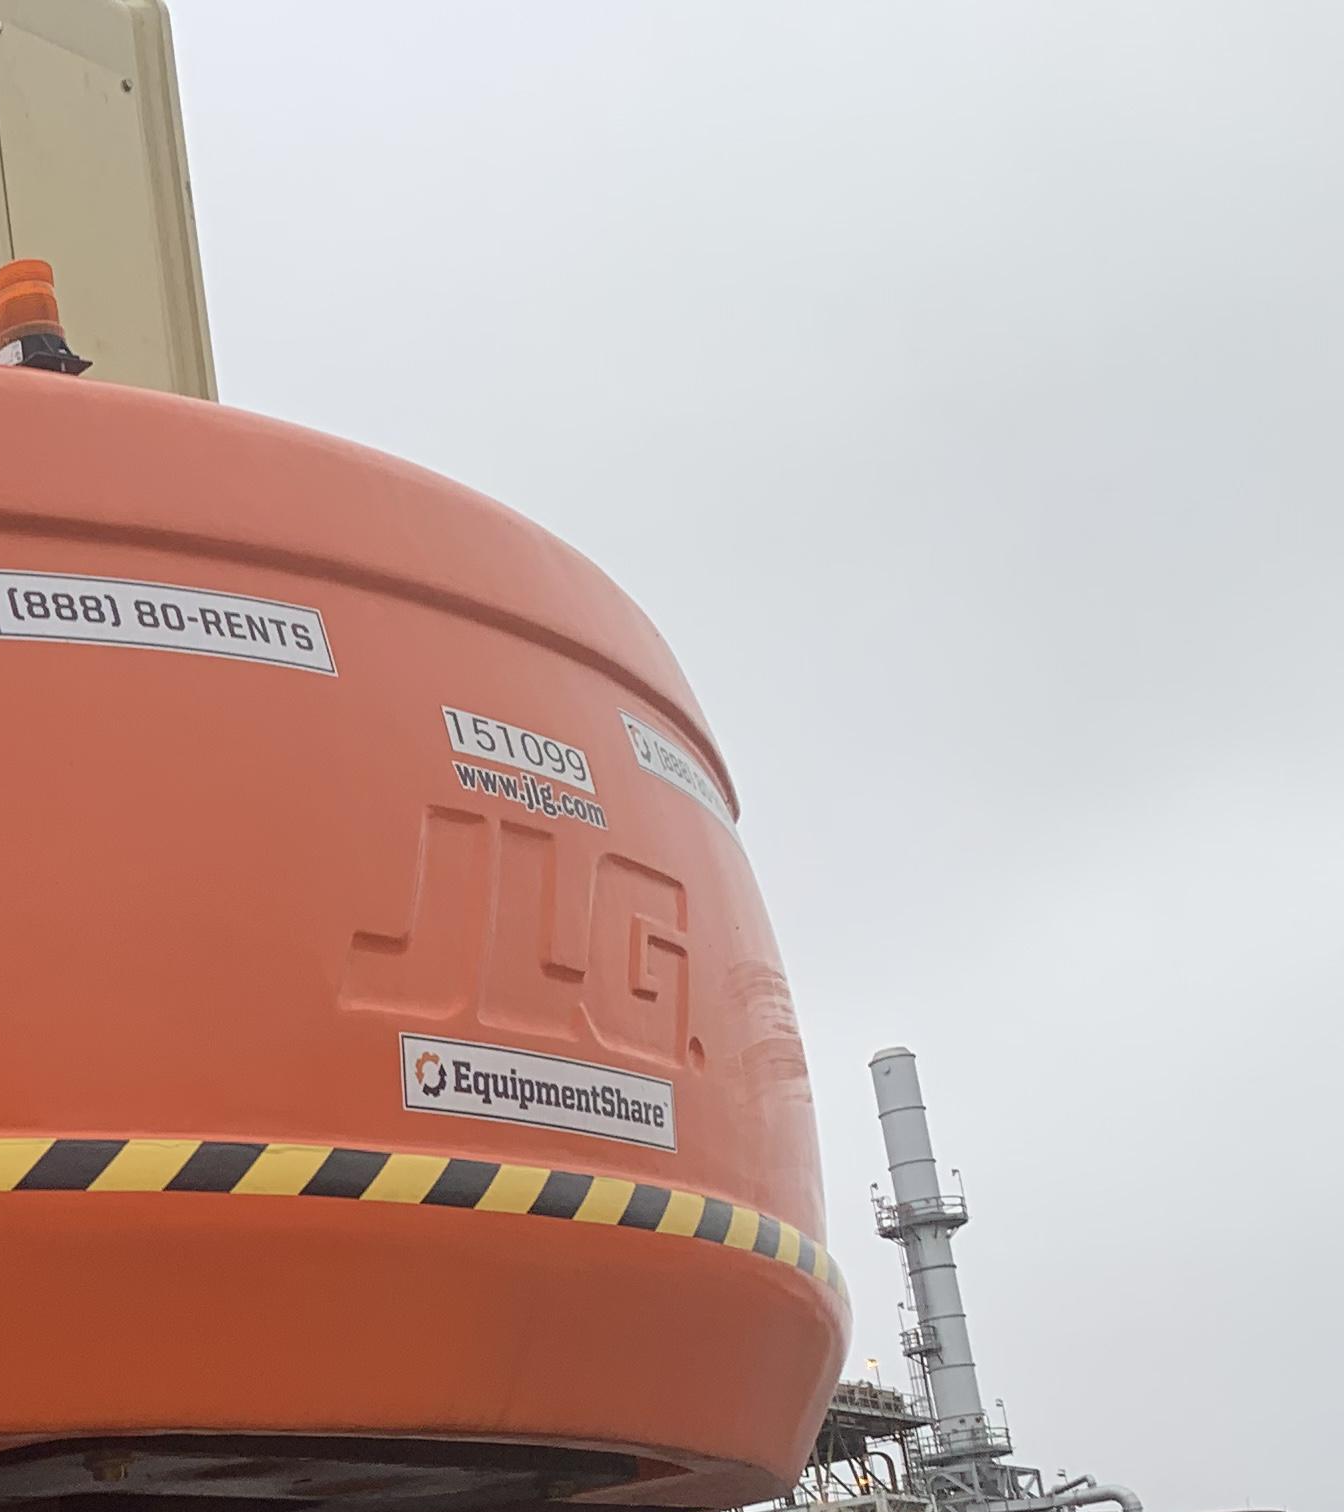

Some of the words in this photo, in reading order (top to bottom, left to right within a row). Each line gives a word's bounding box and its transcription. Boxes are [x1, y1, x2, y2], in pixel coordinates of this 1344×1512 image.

[6, 586, 121, 627] (888)
[133, 599, 315, 652] 80-RENTS
[445, 709, 587, 782] 151099
[454, 763, 607, 828] www.jlg.com
[337, 804, 689, 1069] JLG
[452, 1060, 665, 1129] EquipmentShare
